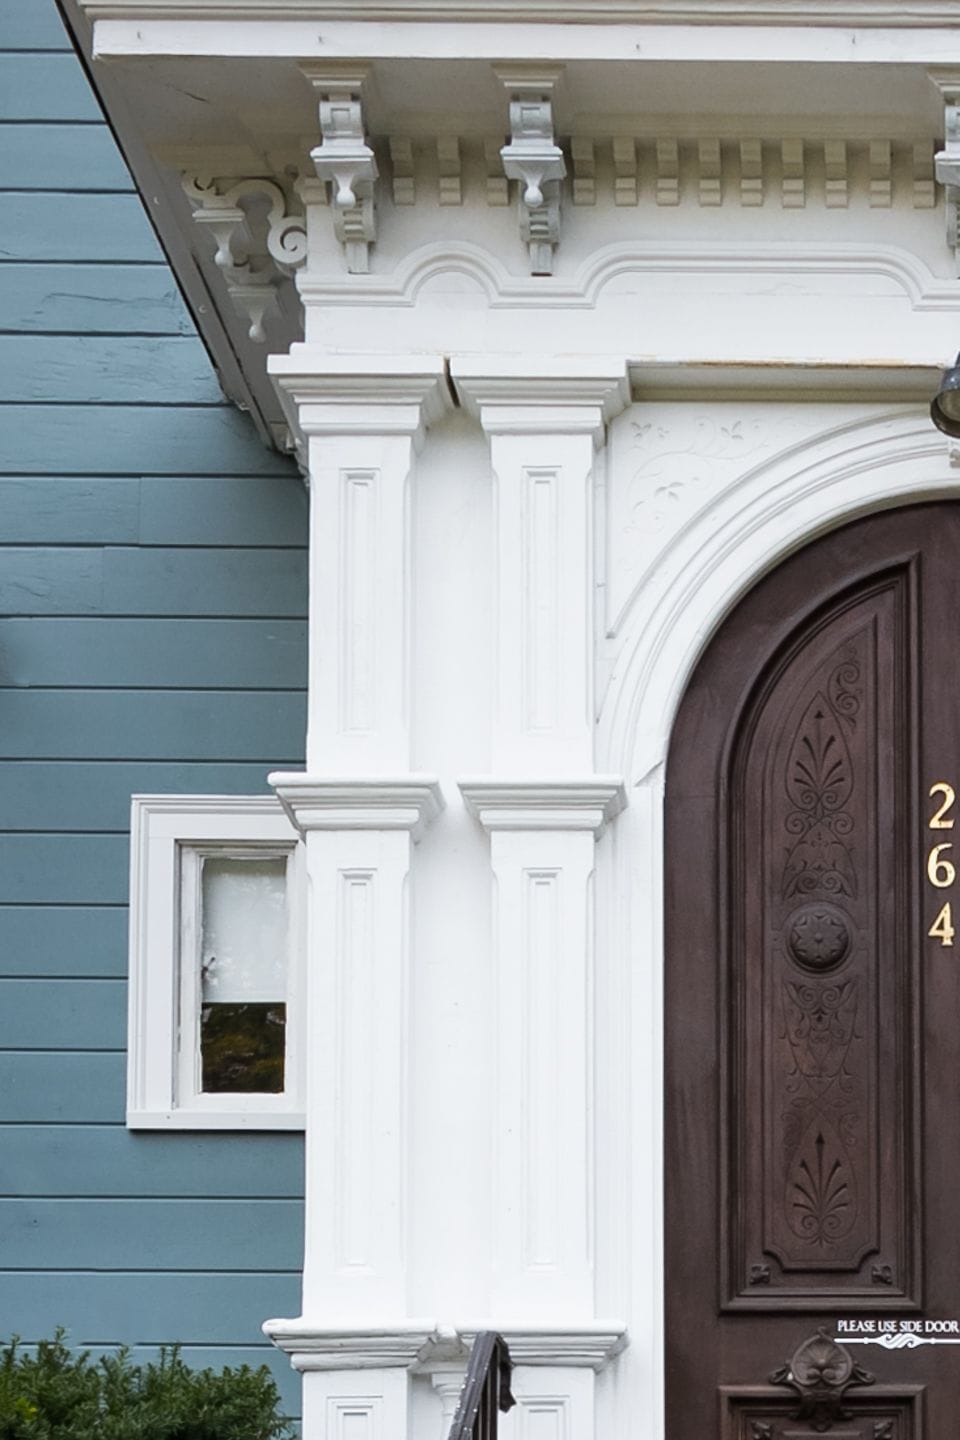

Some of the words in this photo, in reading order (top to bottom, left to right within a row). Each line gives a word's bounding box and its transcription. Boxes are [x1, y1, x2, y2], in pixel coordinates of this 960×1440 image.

[927, 782, 956, 946] 264
[837, 1319, 876, 1333] PLEASE
[878, 1319, 898, 1333] USE
[899, 1319, 923, 1333] SIDE
[925, 1319, 960, 1333] DOOR
